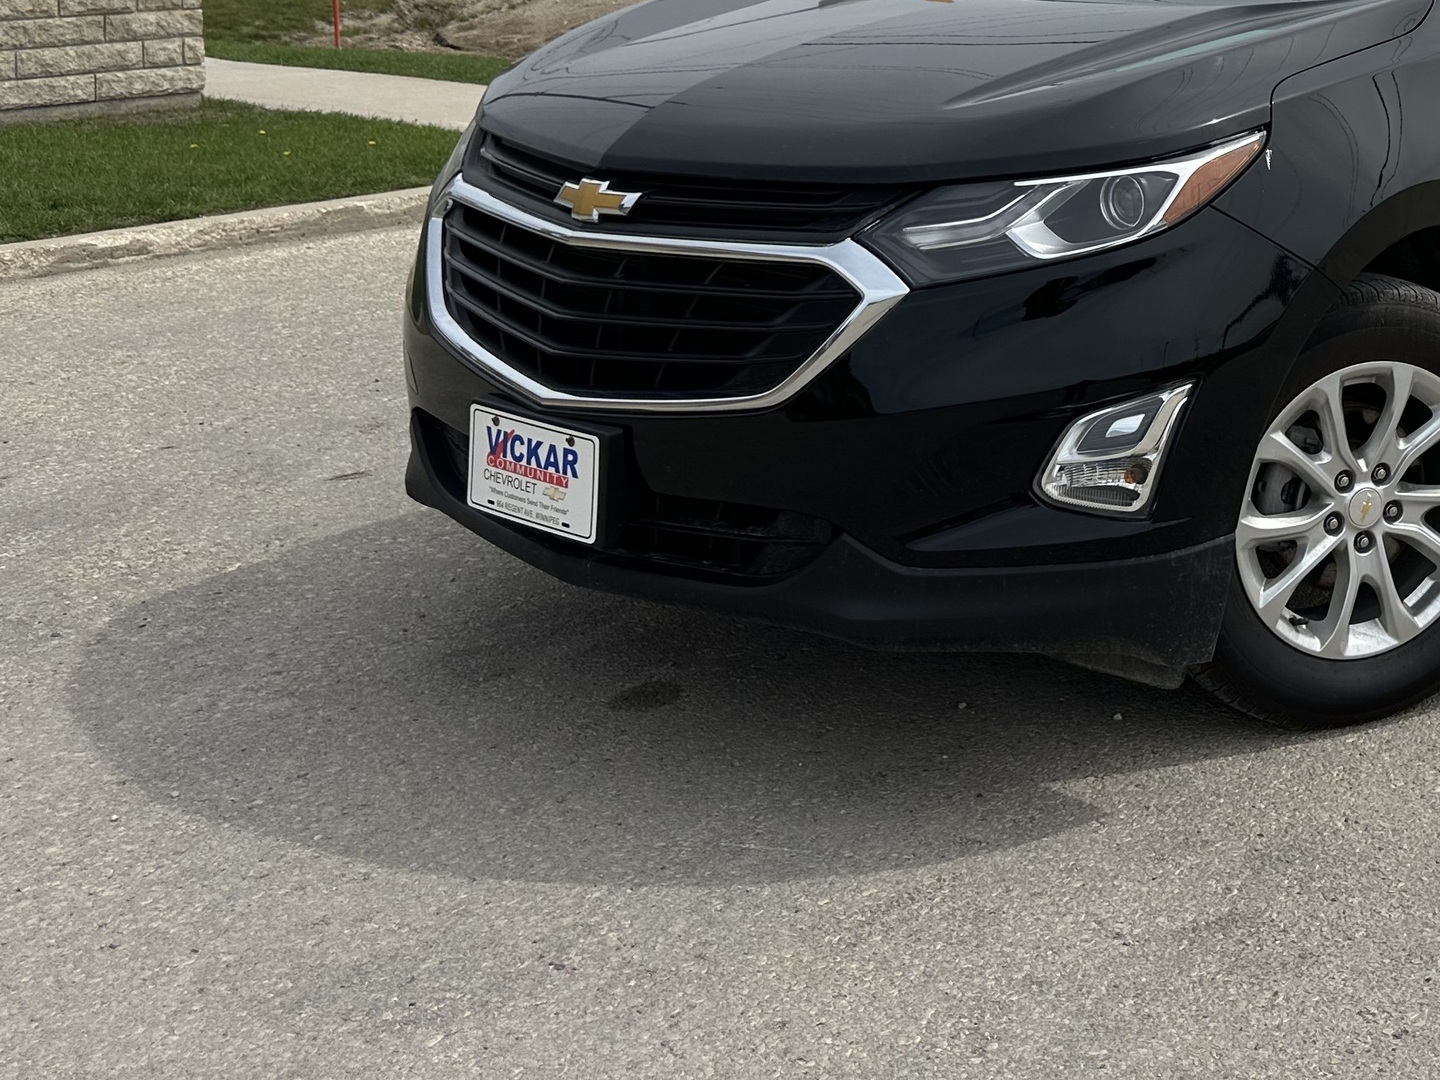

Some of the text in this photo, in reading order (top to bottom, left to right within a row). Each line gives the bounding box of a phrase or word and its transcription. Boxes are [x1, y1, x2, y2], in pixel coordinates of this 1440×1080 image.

[486, 425, 579, 479] VICKAR
[483, 468, 538, 495] CHEVROLET
[487, 455, 568, 487] COMMUNITY
[505, 502, 523, 514] REGENT
[535, 511, 560, 526] WINNIPEG
[527, 498, 538, 507] Send
